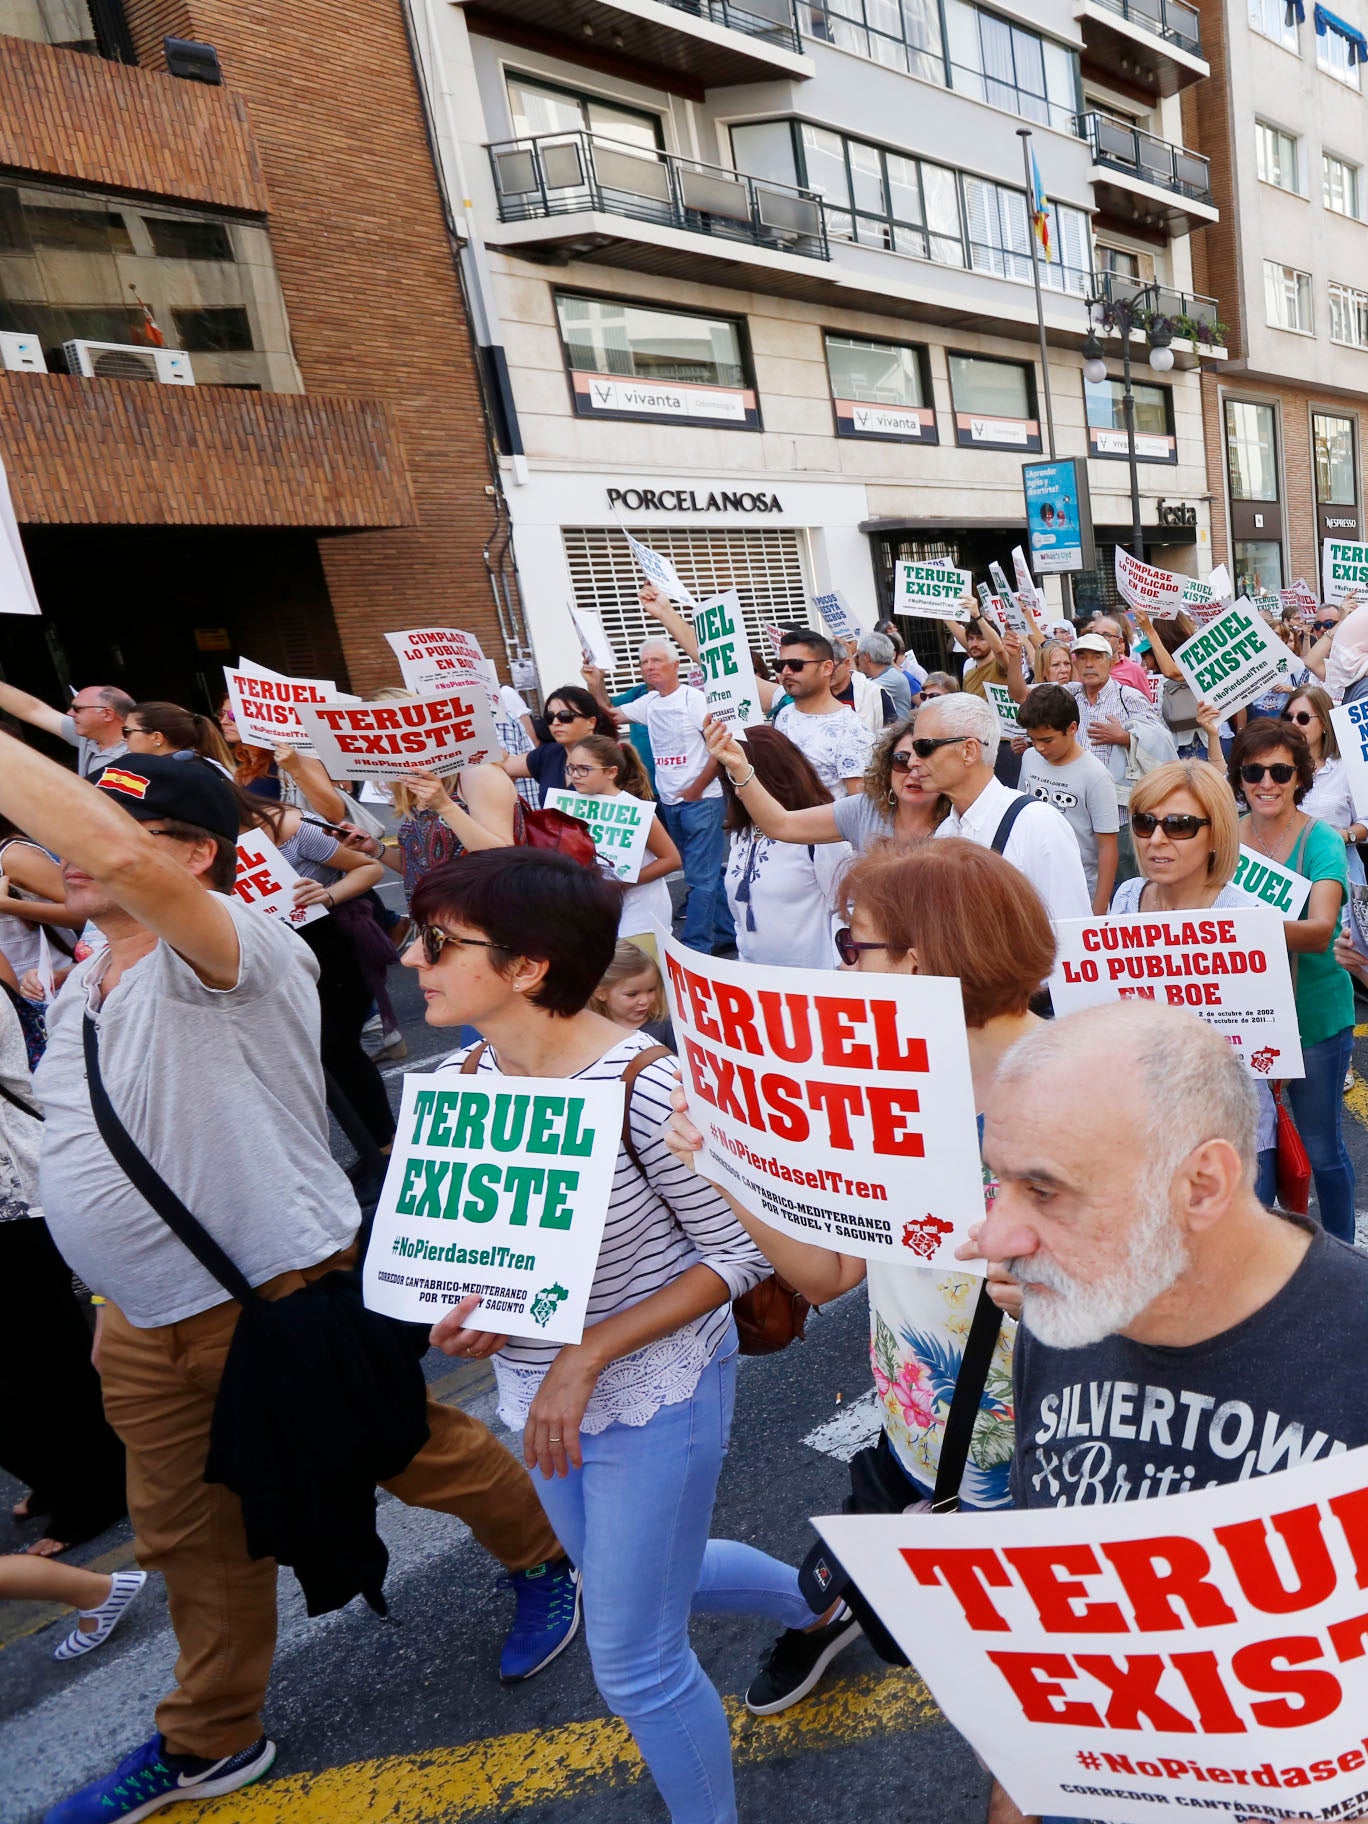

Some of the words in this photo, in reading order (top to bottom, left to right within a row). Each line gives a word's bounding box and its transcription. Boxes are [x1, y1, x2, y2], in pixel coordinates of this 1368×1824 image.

[624, 389, 681, 408] vivanta
[876, 415, 917, 430] vivanta
[1112, 438, 1140, 450] vivaa
[606, 488, 784, 513] PORCELANOSA
[1155, 498, 1198, 526] festa
[1325, 516, 1356, 528] NESPRESSO
[904, 565, 965, 585] TERUEL
[1128, 569, 1179, 592] PUBLICADO
[906, 581, 963, 599] EXISTE
[1128, 579, 1139, 591] EN
[1140, 586, 1160, 599] BOE
[1253, 595, 1279, 605] TERUEL
[694, 604, 735, 646] UEL
[404, 649, 424, 661] LO
[425, 646, 482, 661] PUBLICADO
[1180, 611, 1253, 672] TERUEL
[435, 659, 456, 670] EN
[1194, 630, 1268, 694] EXISTE
[233, 675, 327, 703] TERUEL
[1213, 660, 1269, 702] #NoPierdaselTren
[242, 700, 301, 726] EXIST
[315, 696, 475, 731] TERUEL
[249, 724, 309, 739] #NoPierdaselTre
[334, 719, 476, 754] EXISTE
[354, 750, 462, 768] #NoPierdaselTren
[556, 796, 641, 826] TERUEL
[1232, 854, 1293, 914] RUEL
[1081, 920, 1237, 952] CÚMPLASE
[1062, 960, 1099, 983] LO
[1106, 950, 1268, 981] PUBLICADO
[1165, 983, 1223, 1007] BOE
[664, 949, 930, 1073] TERUEL
[682, 1032, 926, 1158] EXISTE
[411, 1090, 596, 1158] TERUEL
[710, 1122, 889, 1202] #NoPierdaselTren
[395, 1158, 580, 1231] EXISTE
[761, 1198, 780, 1217] POR
[780, 1207, 822, 1232] TERUEL
[825, 1221, 833, 1233] Y
[836, 1224, 894, 1246] SAGUNTO
[392, 1236, 536, 1271] #NoPierdaselTren
[378, 1270, 405, 1286] CORREDOR
[419, 1291, 438, 1303] POR
[485, 1298, 525, 1314] SAGUNTO
[1059, 1783, 1170, 1804] CORREDOR
